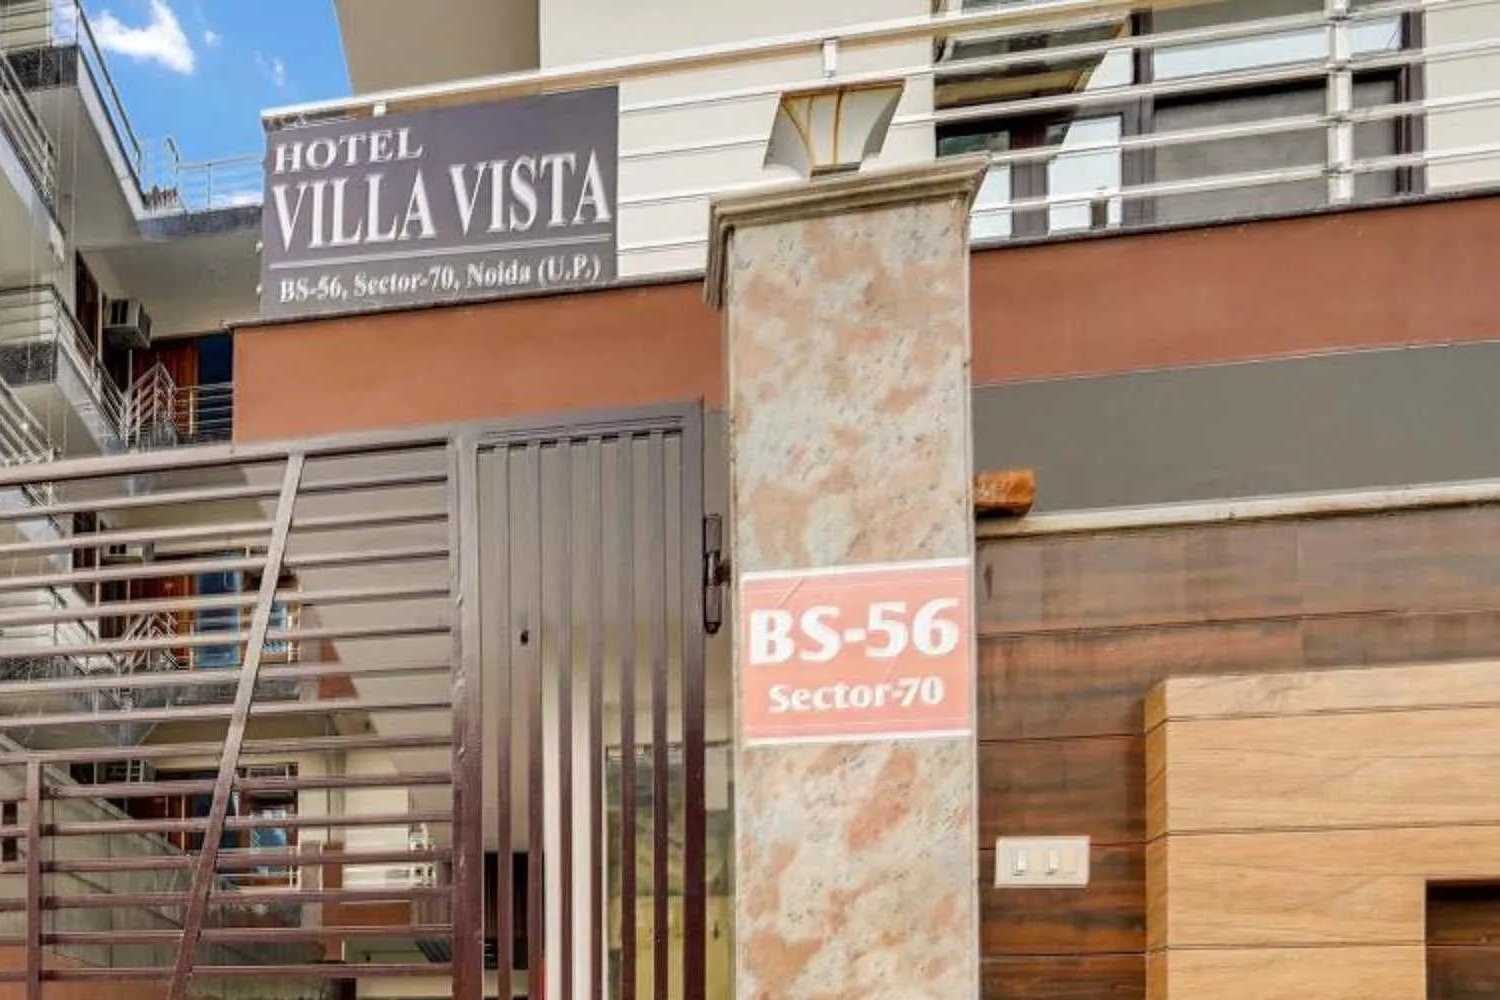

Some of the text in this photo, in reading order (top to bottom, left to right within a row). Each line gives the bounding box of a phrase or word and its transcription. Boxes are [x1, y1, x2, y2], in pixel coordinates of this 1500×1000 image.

[272, 127, 424, 175] HOTEL
[272, 148, 613, 252] VILLA VISTA
[279, 253, 601, 302] BS-56, Sector-70, Noida (U.P.)
[749, 597, 961, 665] BS-56
[768, 675, 945, 713] Sector-70
